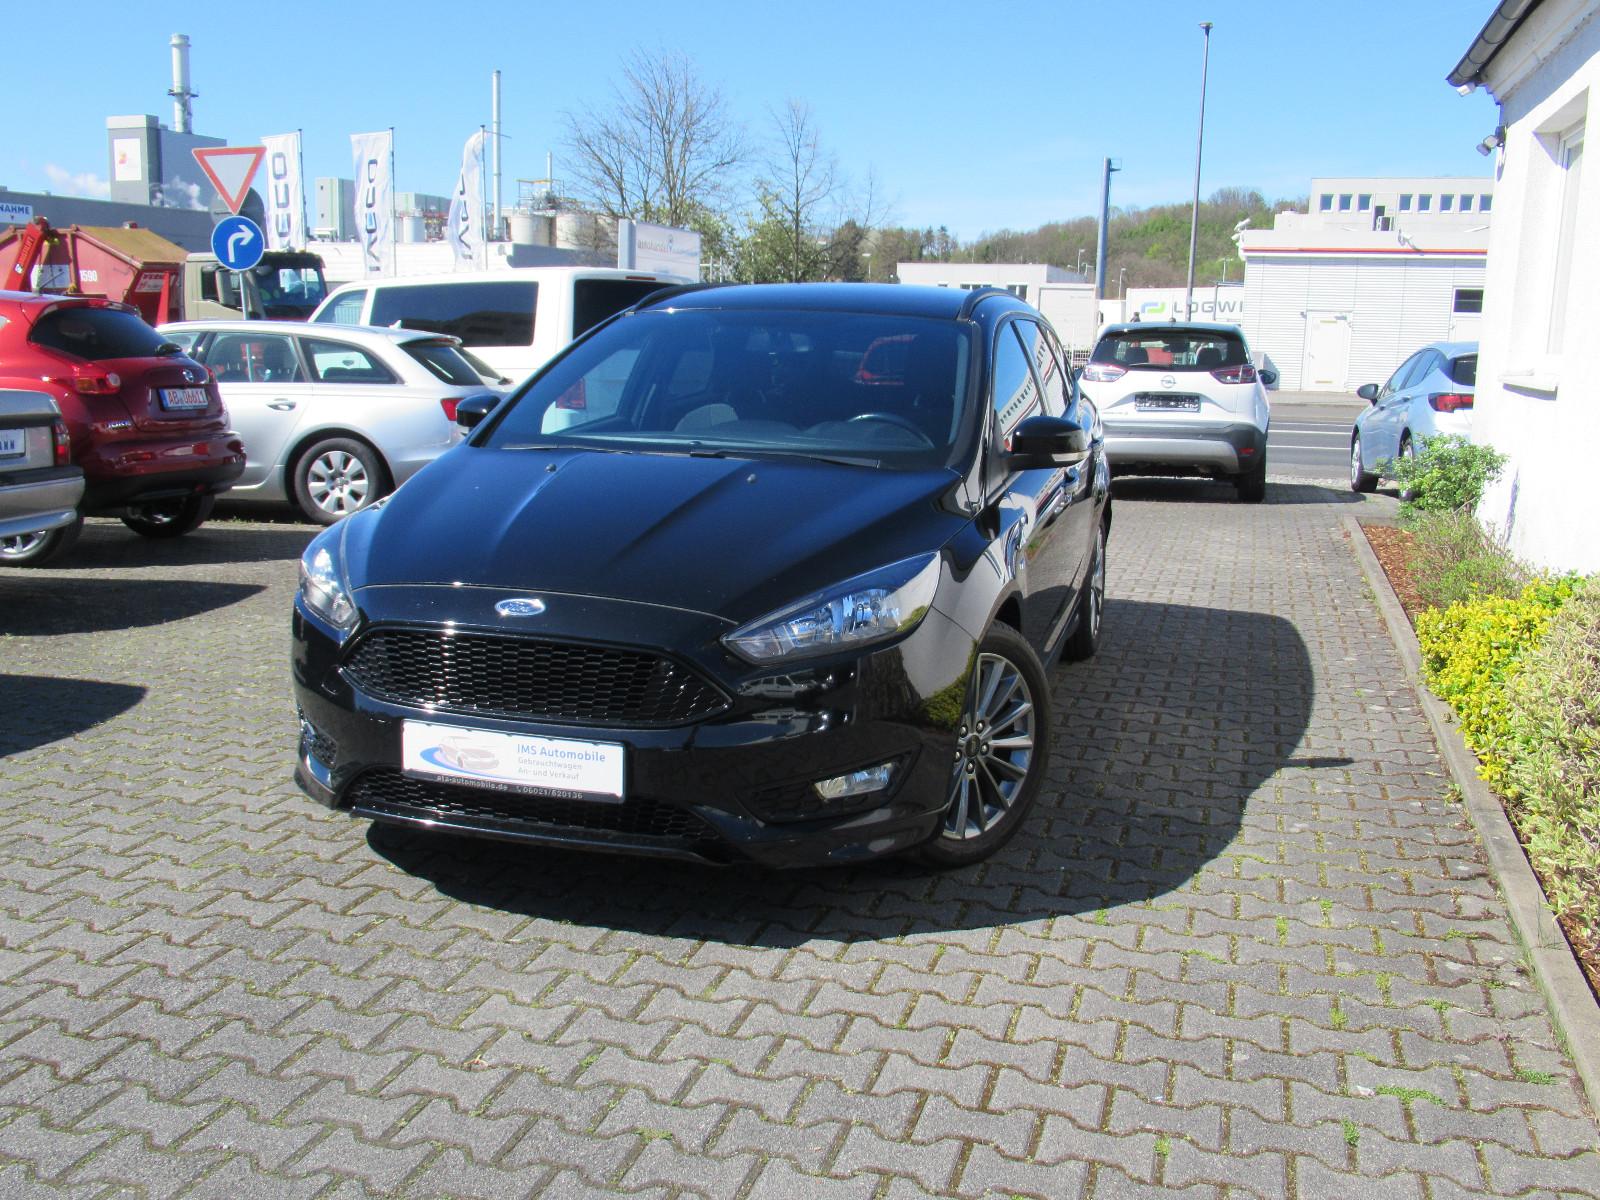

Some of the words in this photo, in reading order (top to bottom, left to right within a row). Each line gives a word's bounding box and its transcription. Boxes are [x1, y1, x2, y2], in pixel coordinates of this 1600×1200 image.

[517, 743, 537, 755] IMS
[540, 746, 606, 762] Automobile
[518, 757, 583, 770] Gebrauchtwagen
[533, 767, 548, 777] und
[549, 769, 580, 780] Verkauf
